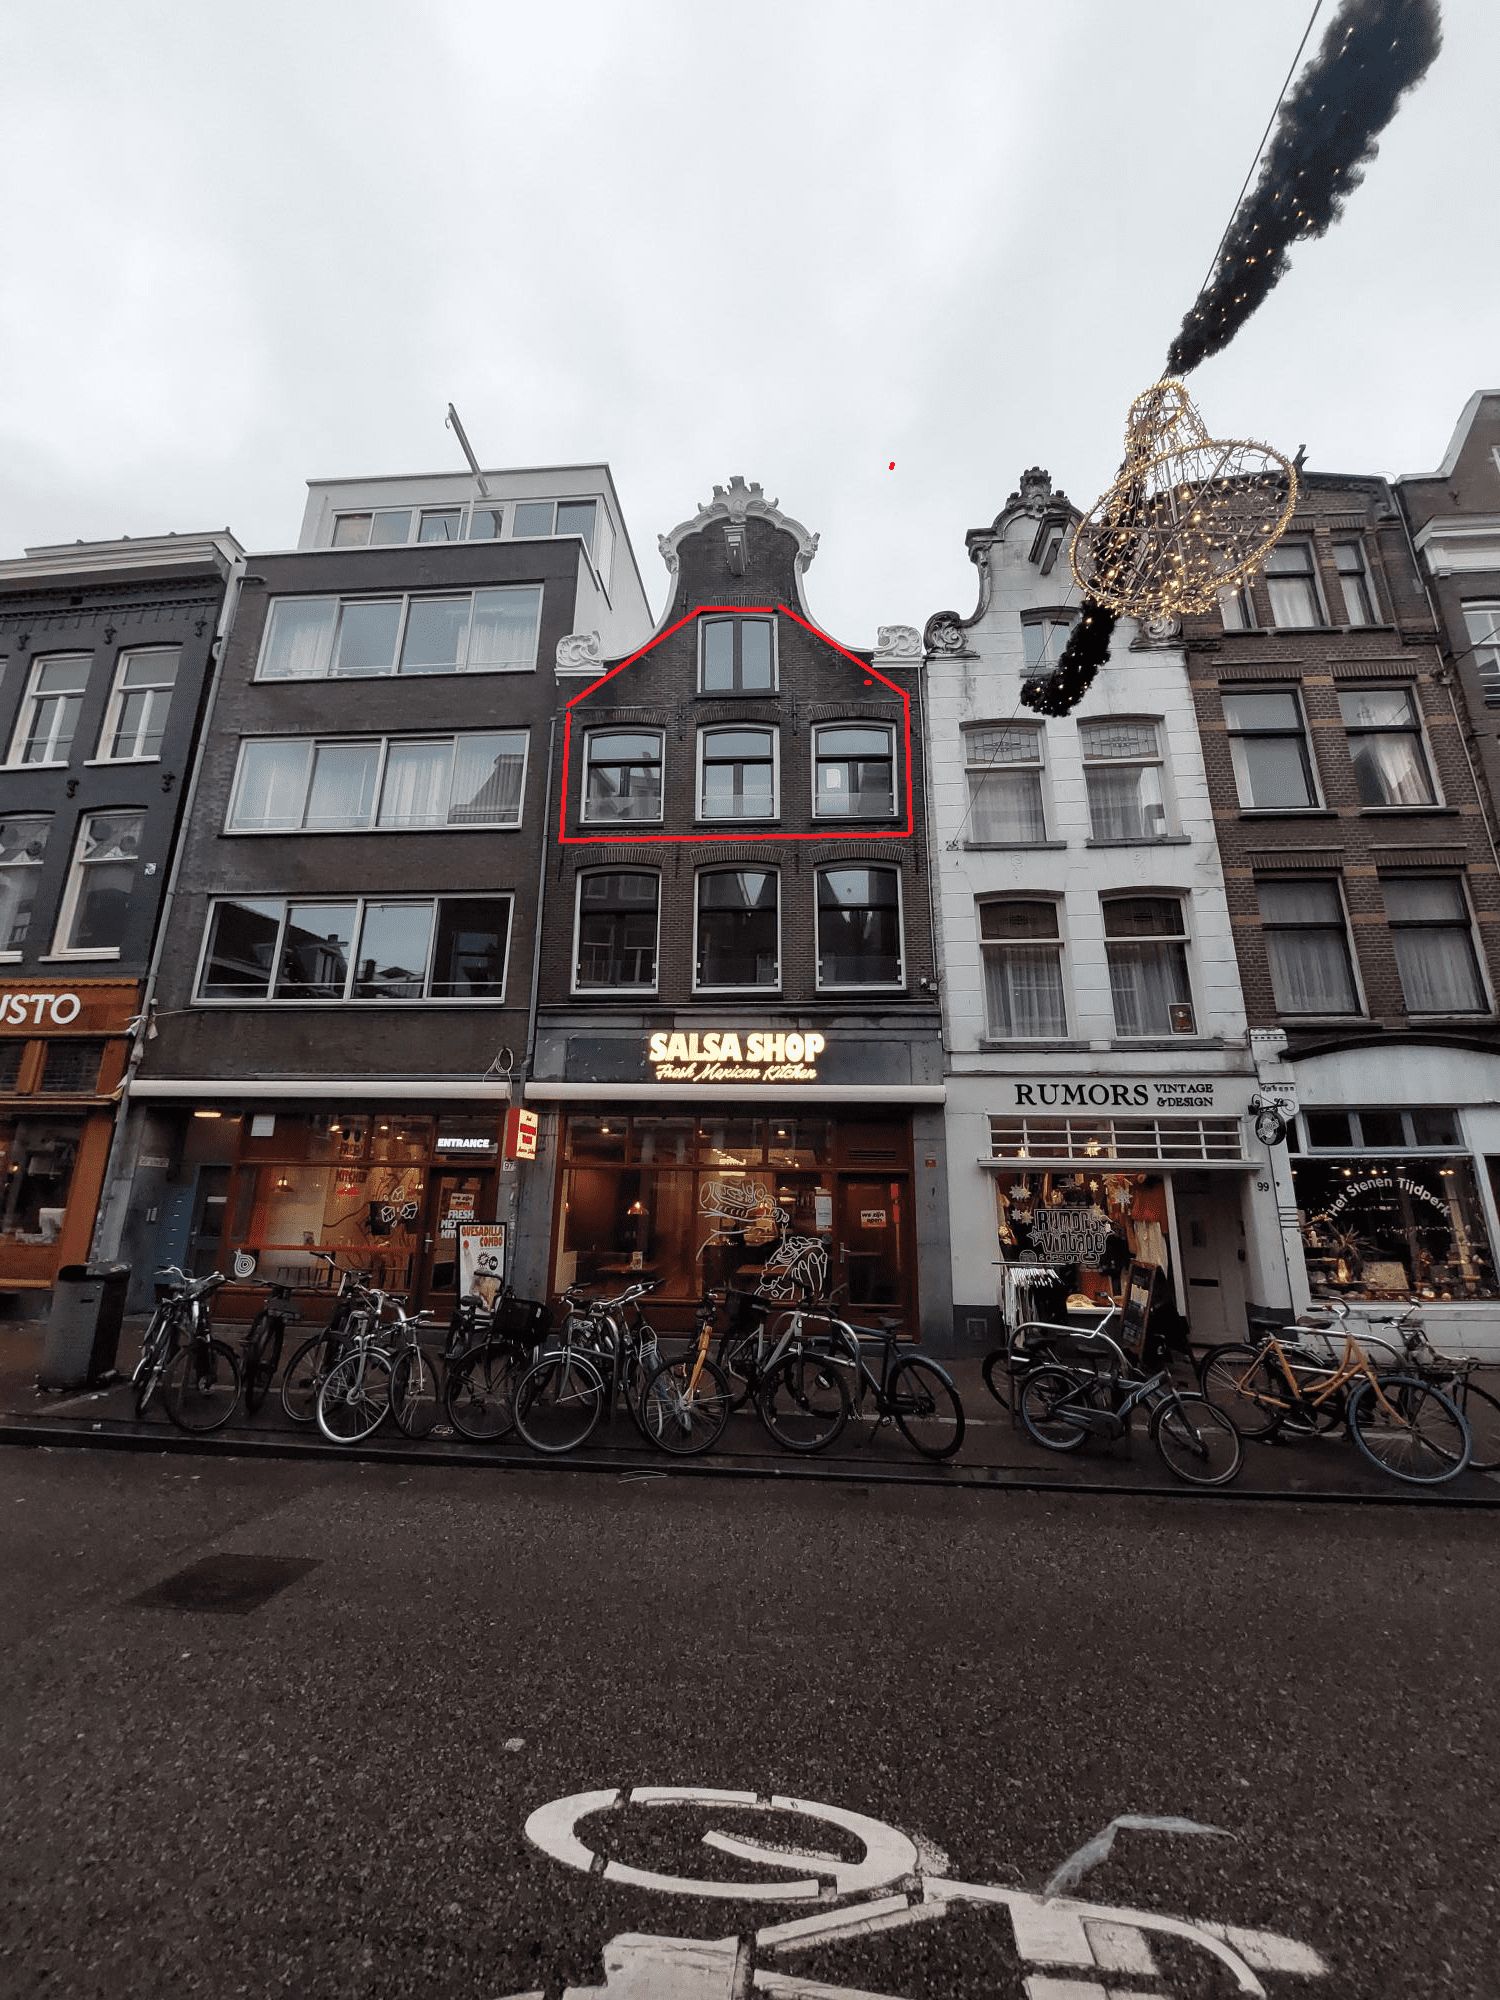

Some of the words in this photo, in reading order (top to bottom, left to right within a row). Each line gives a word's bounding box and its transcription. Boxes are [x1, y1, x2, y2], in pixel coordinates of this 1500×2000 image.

[649, 1032, 743, 1062] SALSA
[746, 1032, 825, 1062] SHOP
[656, 1062, 697, 1080] Fresh
[693, 1063, 761, 1082] Mexican
[762, 1064, 817, 1081] Kitchen
[1153, 1083, 1213, 1093] VINTAGE
[1014, 1084, 1149, 1105] RUMORS
[1157, 1096, 1213, 1107] &DESIGN
[437, 1138, 490, 1148] ENTRANCE
[1257, 1182, 1270, 1192] 99
[1327, 1193, 1349, 1217] Het
[1346, 1177, 1393, 1197] Stenen
[1397, 1177, 1451, 1217] Tijdperk
[448, 1210, 475, 1220] FRESH
[461, 1225, 504, 1237] QUESADILLA
[480, 1236, 503, 1247] COMBO
[1046, 1252, 1079, 1264] design
